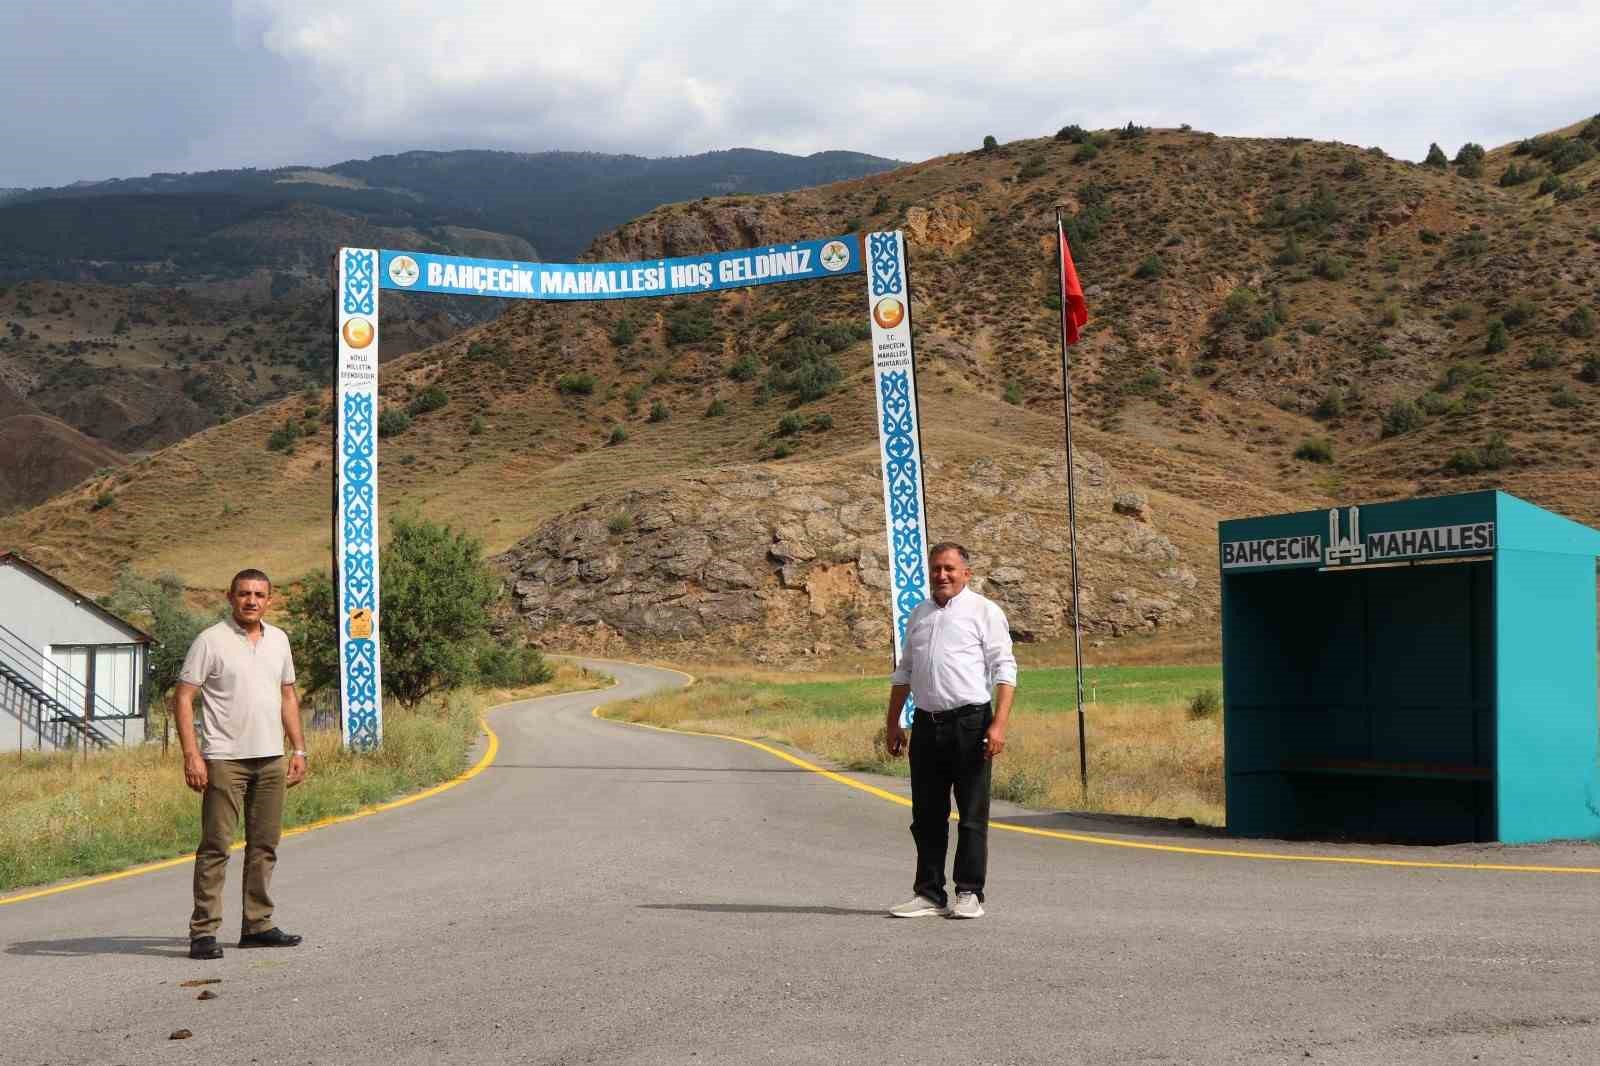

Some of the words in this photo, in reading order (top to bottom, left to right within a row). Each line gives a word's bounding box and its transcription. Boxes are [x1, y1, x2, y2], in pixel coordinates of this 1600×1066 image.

[427, 262, 535, 294] BAHÇECİK
[540, 261, 665, 294] MAHALLESİ
[671, 262, 713, 289] HOŞ
[719, 245, 813, 283] GELDİNİZ
